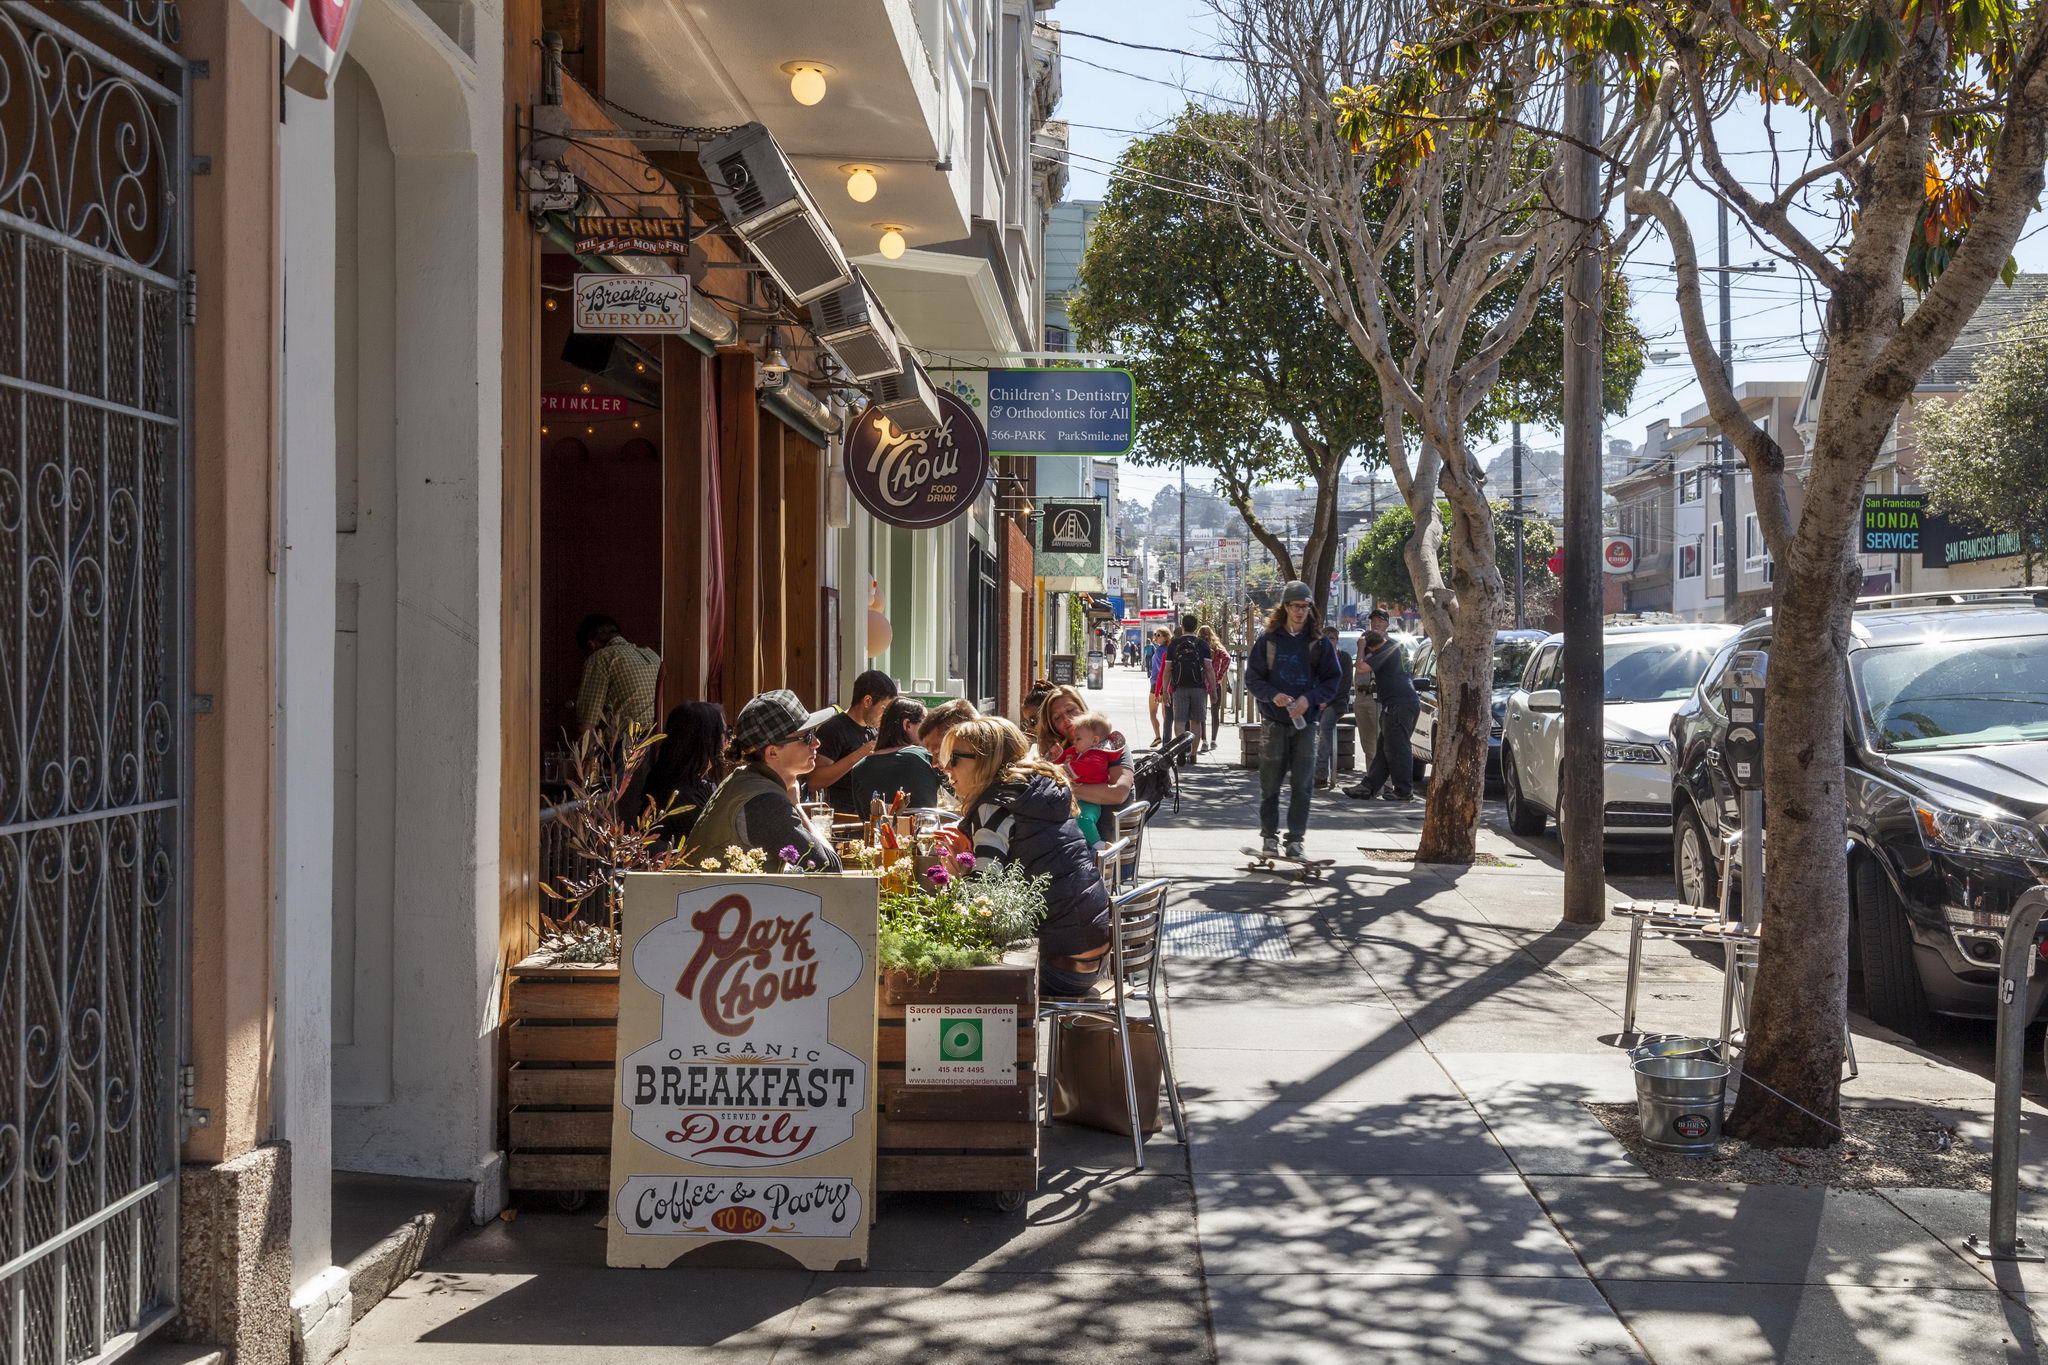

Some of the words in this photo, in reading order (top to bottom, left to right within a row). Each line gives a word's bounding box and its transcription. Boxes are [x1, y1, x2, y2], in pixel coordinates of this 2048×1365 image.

[579, 218, 684, 236] INTERNET
[634, 240, 657, 252] MON
[658, 242, 664, 250] to
[666, 241, 684, 252] FRI
[586, 286, 677, 313] Breakfast
[584, 312, 680, 325] EVERYDAY
[1066, 389, 1130, 404] Dentistry
[990, 406, 1002, 418] &
[1006, 407, 1086, 418] Orthodontics
[1089, 408, 1107, 418] for
[1110, 408, 1129, 419] All
[992, 430, 1046, 440] 566-PARK
[1058, 431, 1128, 440] ParkSmile.net
[879, 439, 958, 506] Chow
[931, 485, 958, 493] FOOD
[927, 494, 956, 502] DRINK
[1866, 498, 1880, 508] San
[1882, 498, 1920, 508] Francisco
[1866, 512, 1918, 528] HONDA
[1866, 532, 1918, 549] SERVICE
[1946, 542, 1958, 562] SAN
[1960, 536, 1996, 560] FRANCISCO
[675, 893, 817, 1000] Park
[700, 946, 818, 1037] Chow
[910, 1006, 942, 1014] Sacred
[944, 1006, 972, 1015] Space
[976, 1006, 1014, 1014] Gardens
[668, 1042, 821, 1062] ORGANIC
[634, 1065, 854, 1108] BREAKFAST
[908, 1078, 1014, 1086] www.sacredspacegardens.com
[721, 1112, 756, 1121] SERVED
[665, 1112, 818, 1158] Daily
[635, 1180, 724, 1228] Coffee
[730, 1182, 756, 1204] &
[764, 1180, 850, 1223] Pastry
[716, 1210, 736, 1230] TO
[742, 1210, 762, 1230] GO
